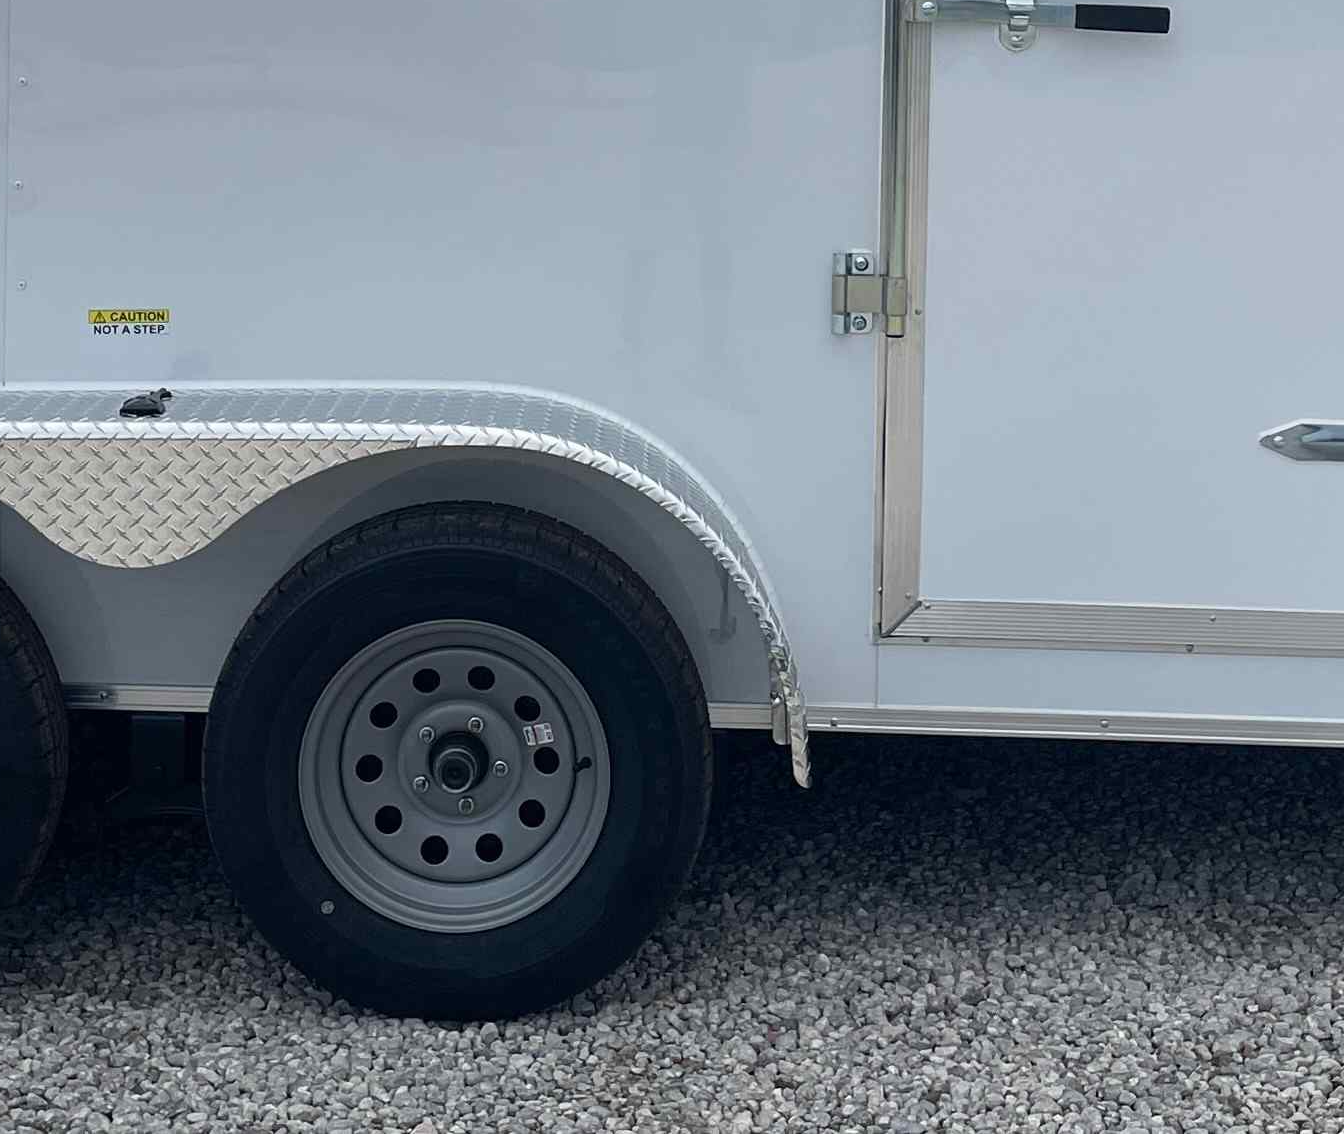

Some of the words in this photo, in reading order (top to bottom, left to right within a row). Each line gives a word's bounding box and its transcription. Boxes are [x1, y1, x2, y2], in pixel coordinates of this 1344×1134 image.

[110, 311, 165, 322] CAUTION
[94, 325, 119, 335] NOT
[121, 325, 131, 335] A
[134, 324, 165, 335] STEP
